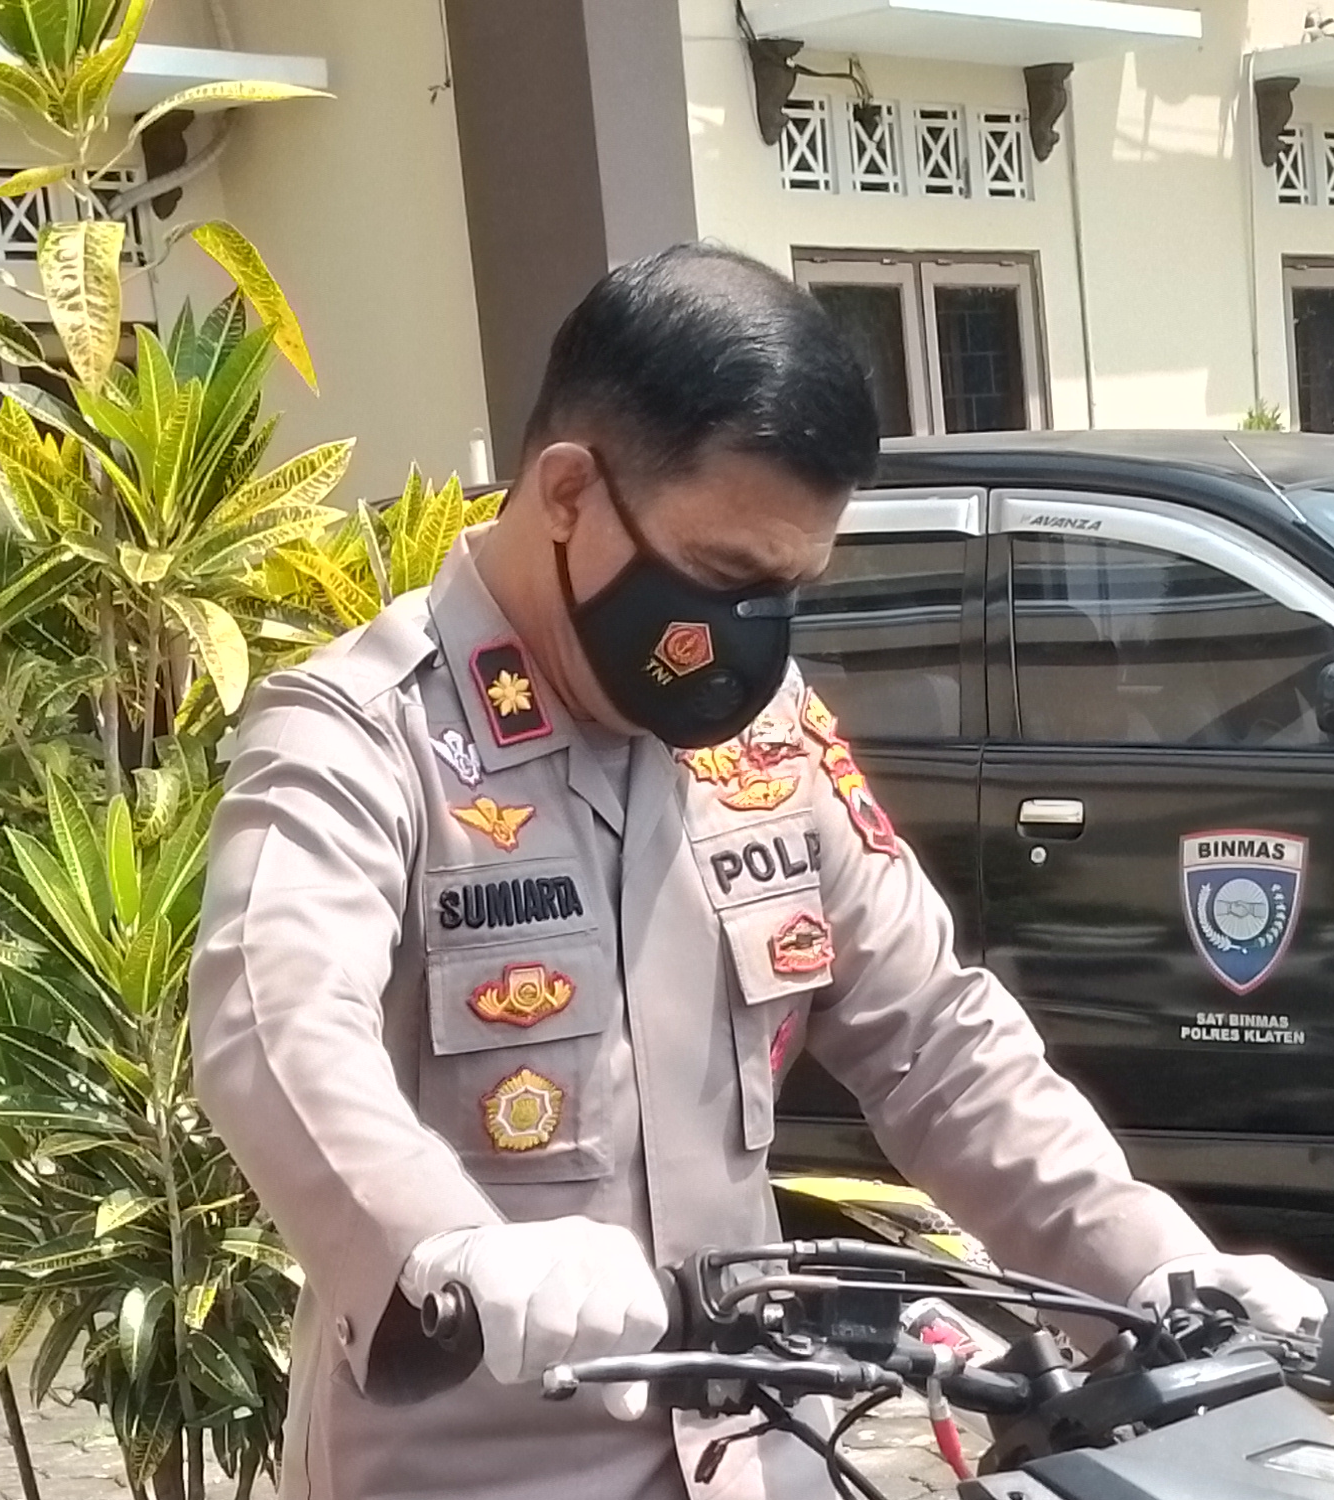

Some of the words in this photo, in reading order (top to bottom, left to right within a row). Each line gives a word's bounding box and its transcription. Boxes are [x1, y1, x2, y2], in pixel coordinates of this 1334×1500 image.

[1029, 514, 1102, 532] AVANZA
[641, 657, 674, 686] TNI
[1197, 840, 1285, 860] BINMAS
[439, 876, 584, 930] SUMIARTA
[1196, 1012, 1224, 1026] SAT
[1229, 1014, 1289, 1028] BINMAS
[1180, 1027, 1240, 1042] POLRES
[1244, 1029, 1305, 1045] KLATEN
